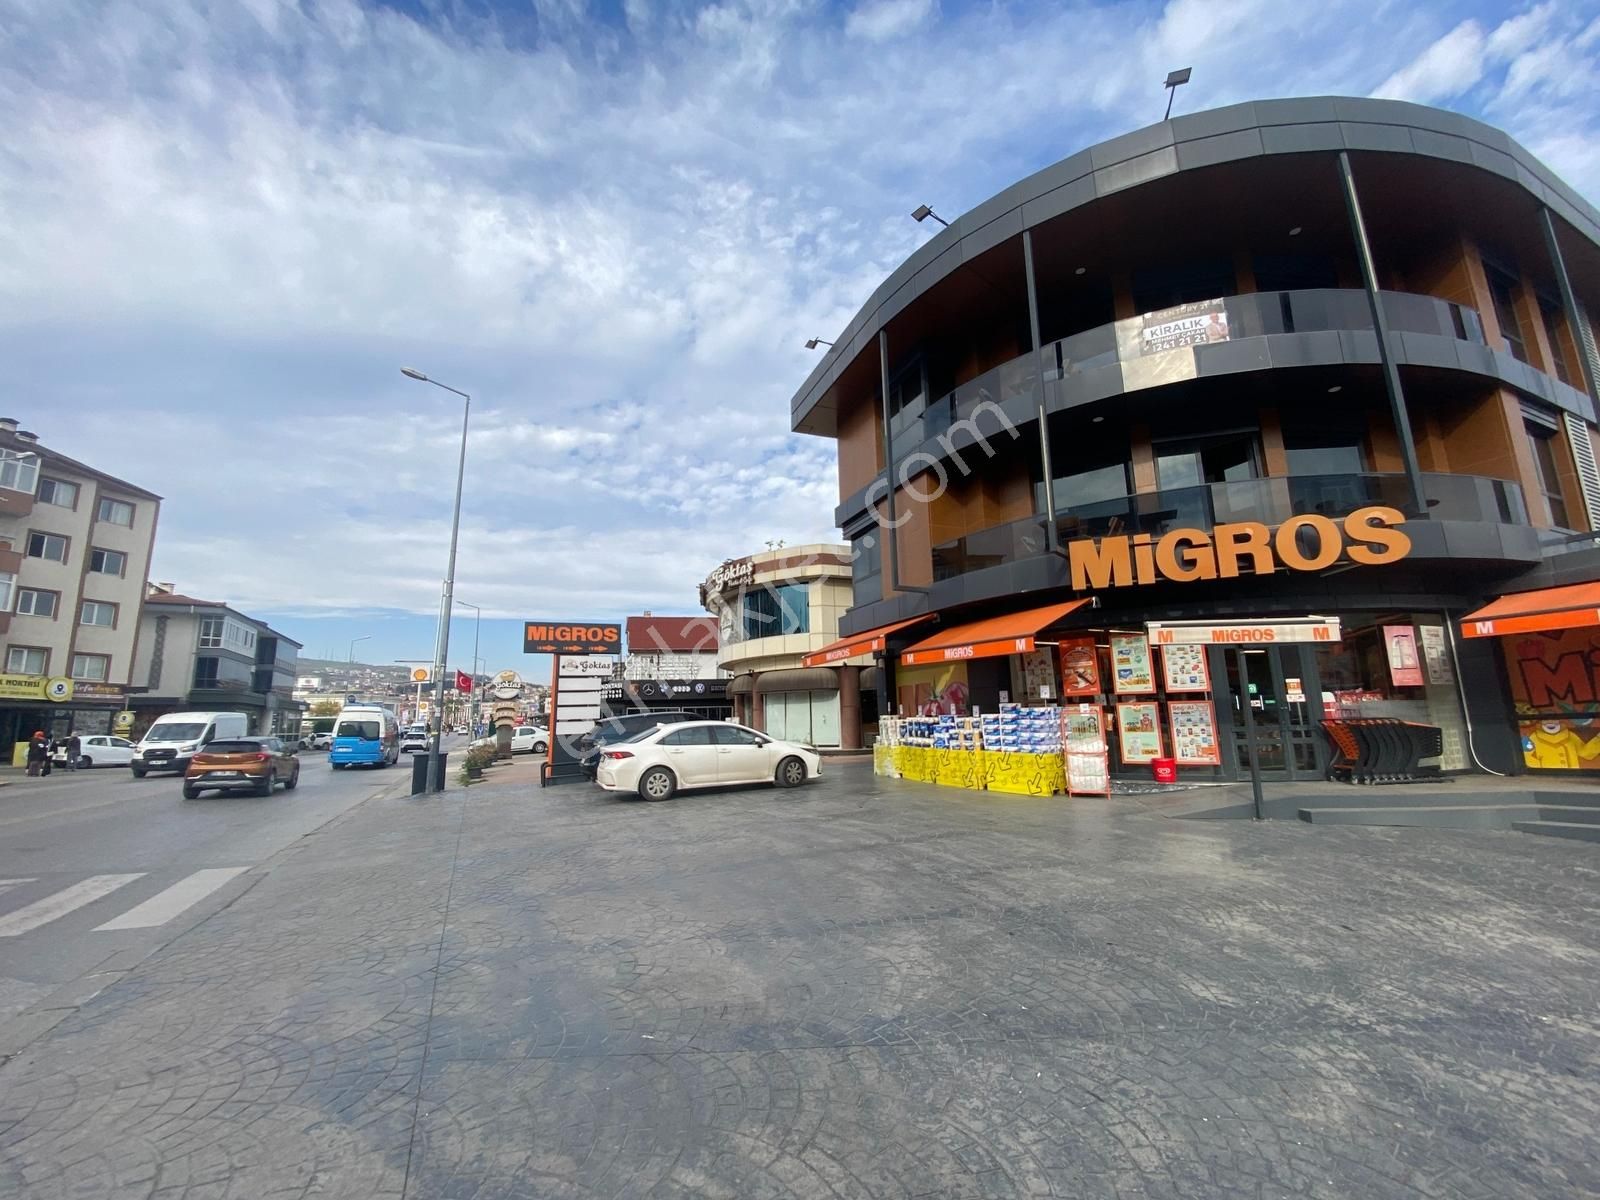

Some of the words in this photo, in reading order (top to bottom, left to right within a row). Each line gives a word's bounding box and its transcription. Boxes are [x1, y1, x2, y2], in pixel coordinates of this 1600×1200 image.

[1150, 319, 1203, 338] KİRALIK
[1151, 333, 1180, 345] MEHMET
[1179, 337, 1191, 346] 21
[1194, 334, 1207, 343] 21
[712, 561, 754, 591] Göktaş
[1313, 627, 1330, 641] M
[1475, 621, 1494, 635] M
[1158, 630, 1174, 643] M
[1015, 638, 1026, 651] M
[907, 653, 914, 663] M
